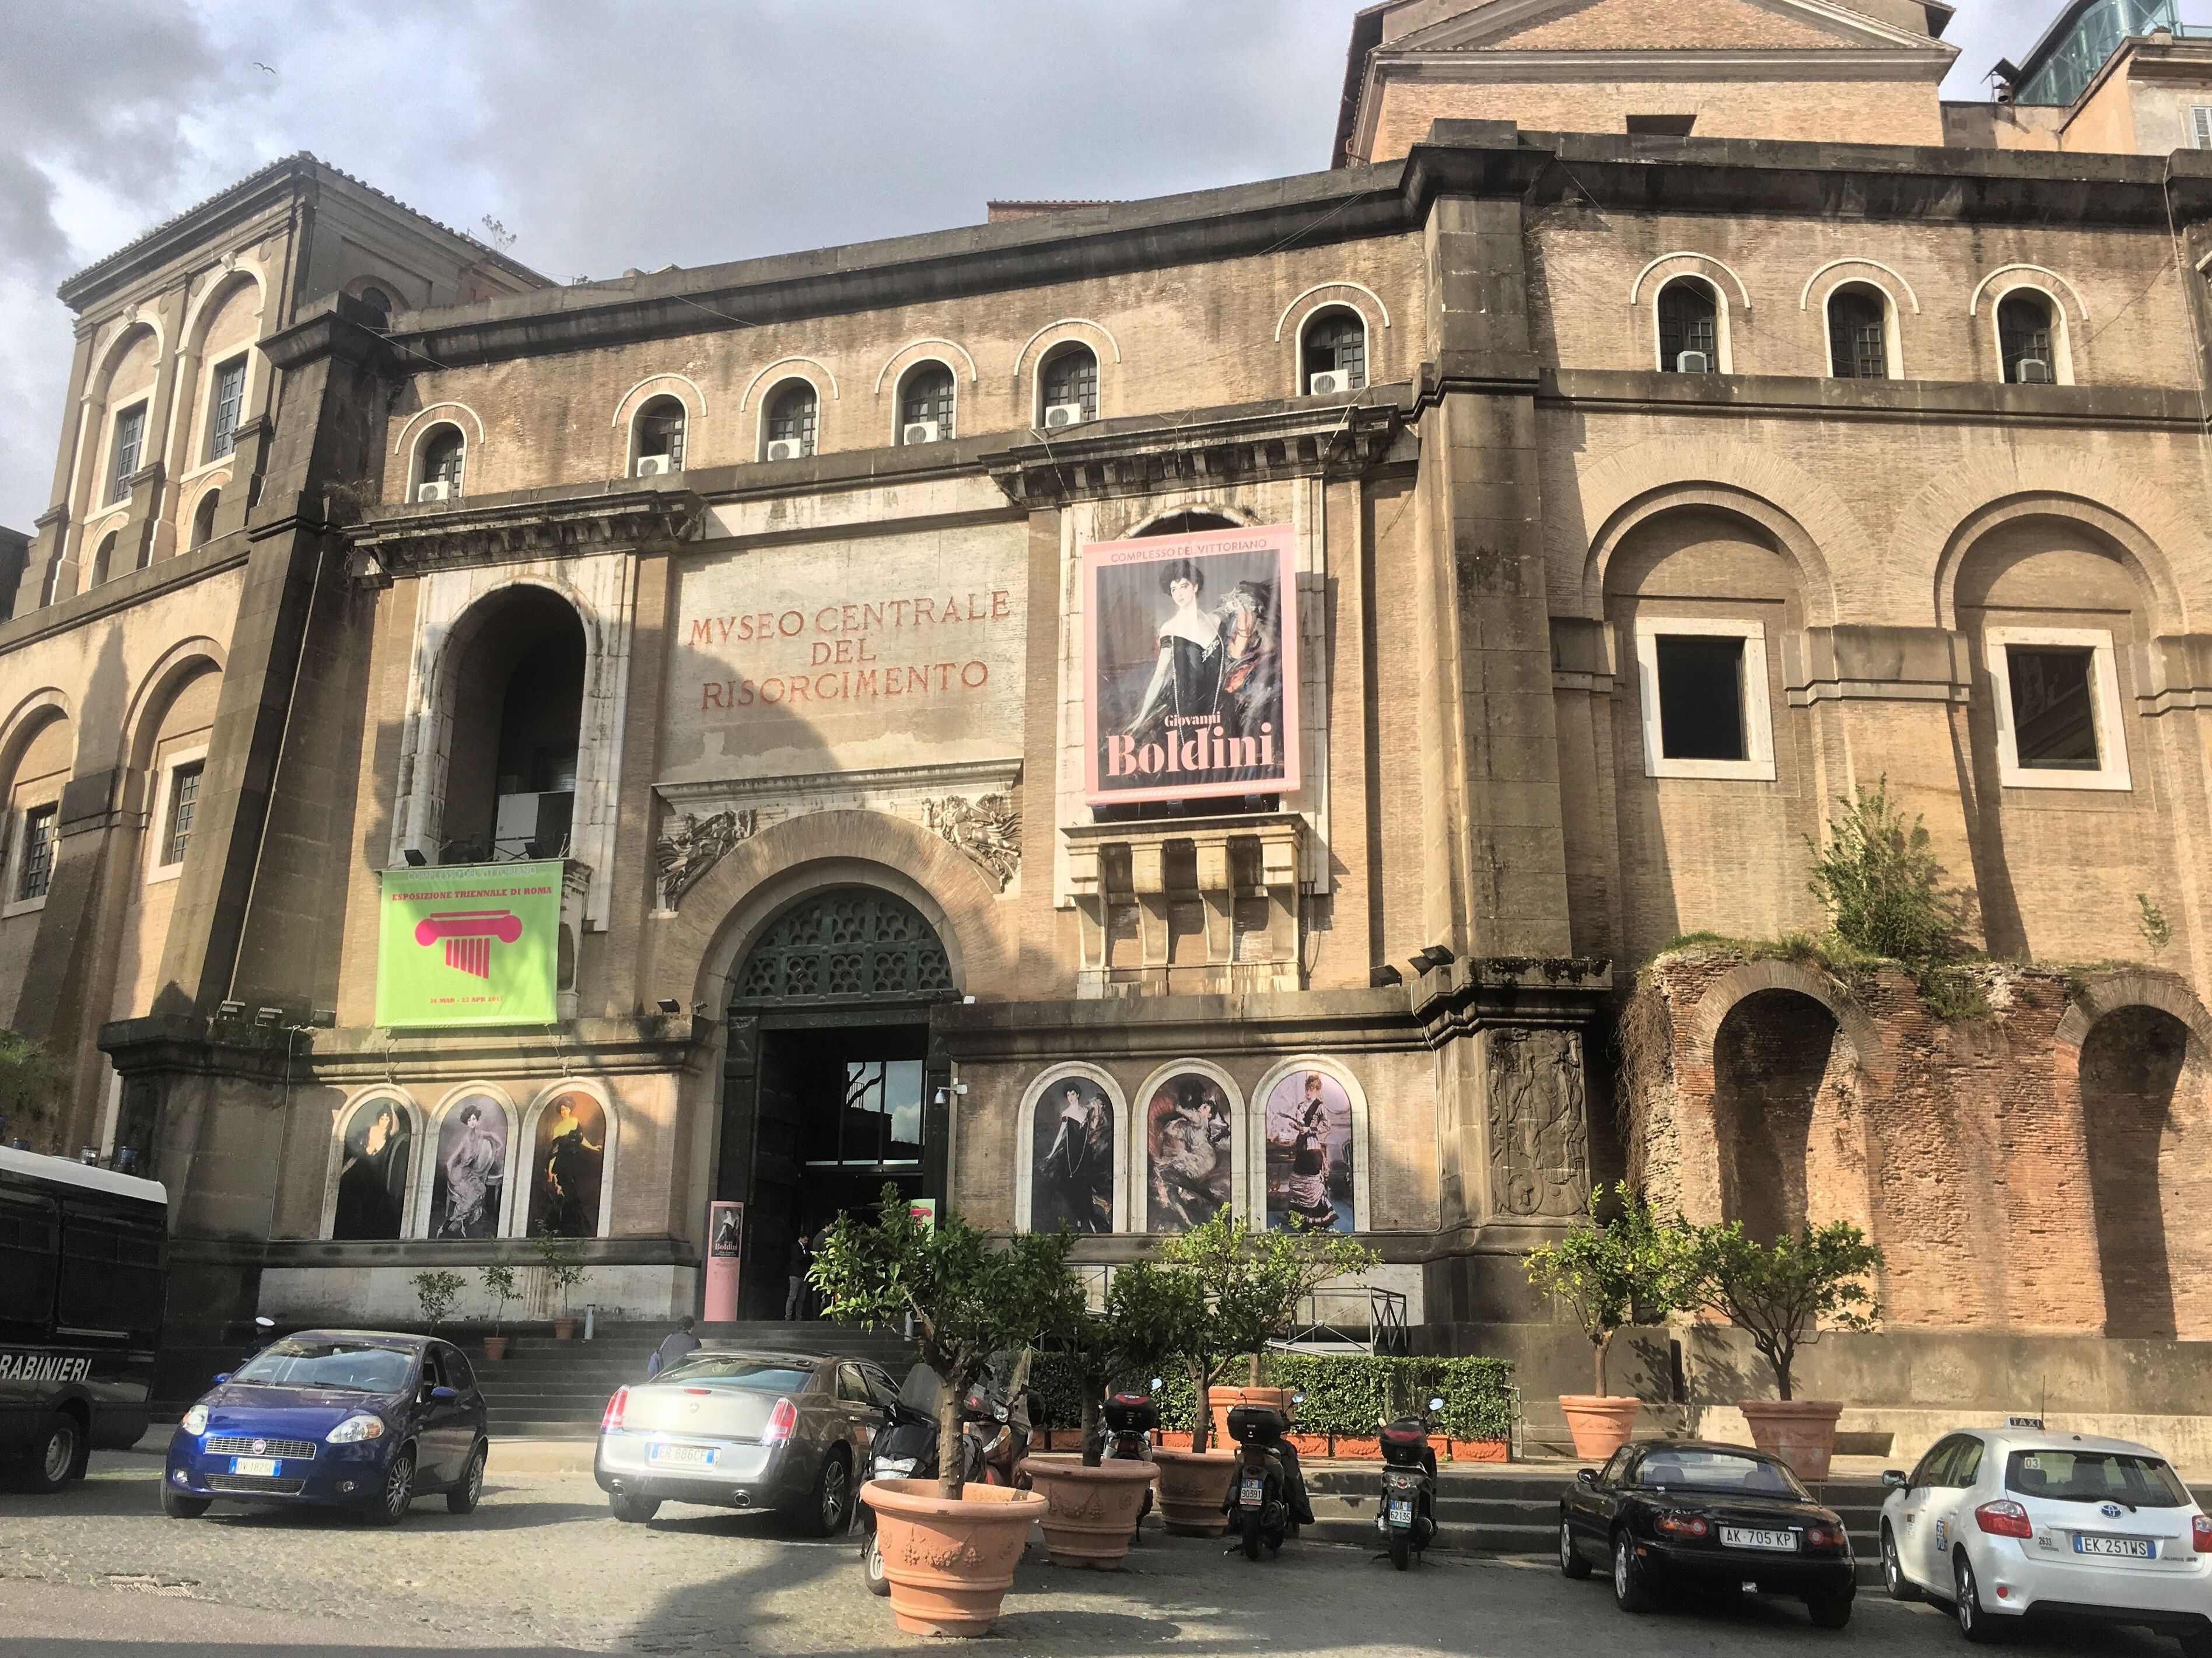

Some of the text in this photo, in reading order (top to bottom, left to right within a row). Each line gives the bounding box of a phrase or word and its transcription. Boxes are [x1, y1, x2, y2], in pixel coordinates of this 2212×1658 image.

[1111, 539, 1267, 562] COMPLESSO DEL VITTORIANO
[688, 589, 1011, 647] MVSEO CENTRALE
[810, 638, 877, 667] DEL
[701, 660, 989, 711] RISORCIMENTO
[1164, 710, 1222, 727] Giovanni
[1105, 722, 1275, 777] Boldini
[408, 870, 461, 880] COMPLESSO
[480, 866, 537, 877] VITTORIANO
[391, 886, 552, 901] ESPOSIZIONE TRIENNALE DI ROMA
[2011, 1418, 2040, 1428] TAXI
[2025, 1458, 2039, 1468] 03
[1241, 1489, 1261, 1498] 90391
[1391, 1510, 1410, 1521] 62135
[1727, 1529, 1791, 1546] AK 705 KP
[2039, 1536, 2052, 1546] 2633
[2084, 1538, 2101, 1552] EK
[2105, 1539, 2147, 1556] 251WS
